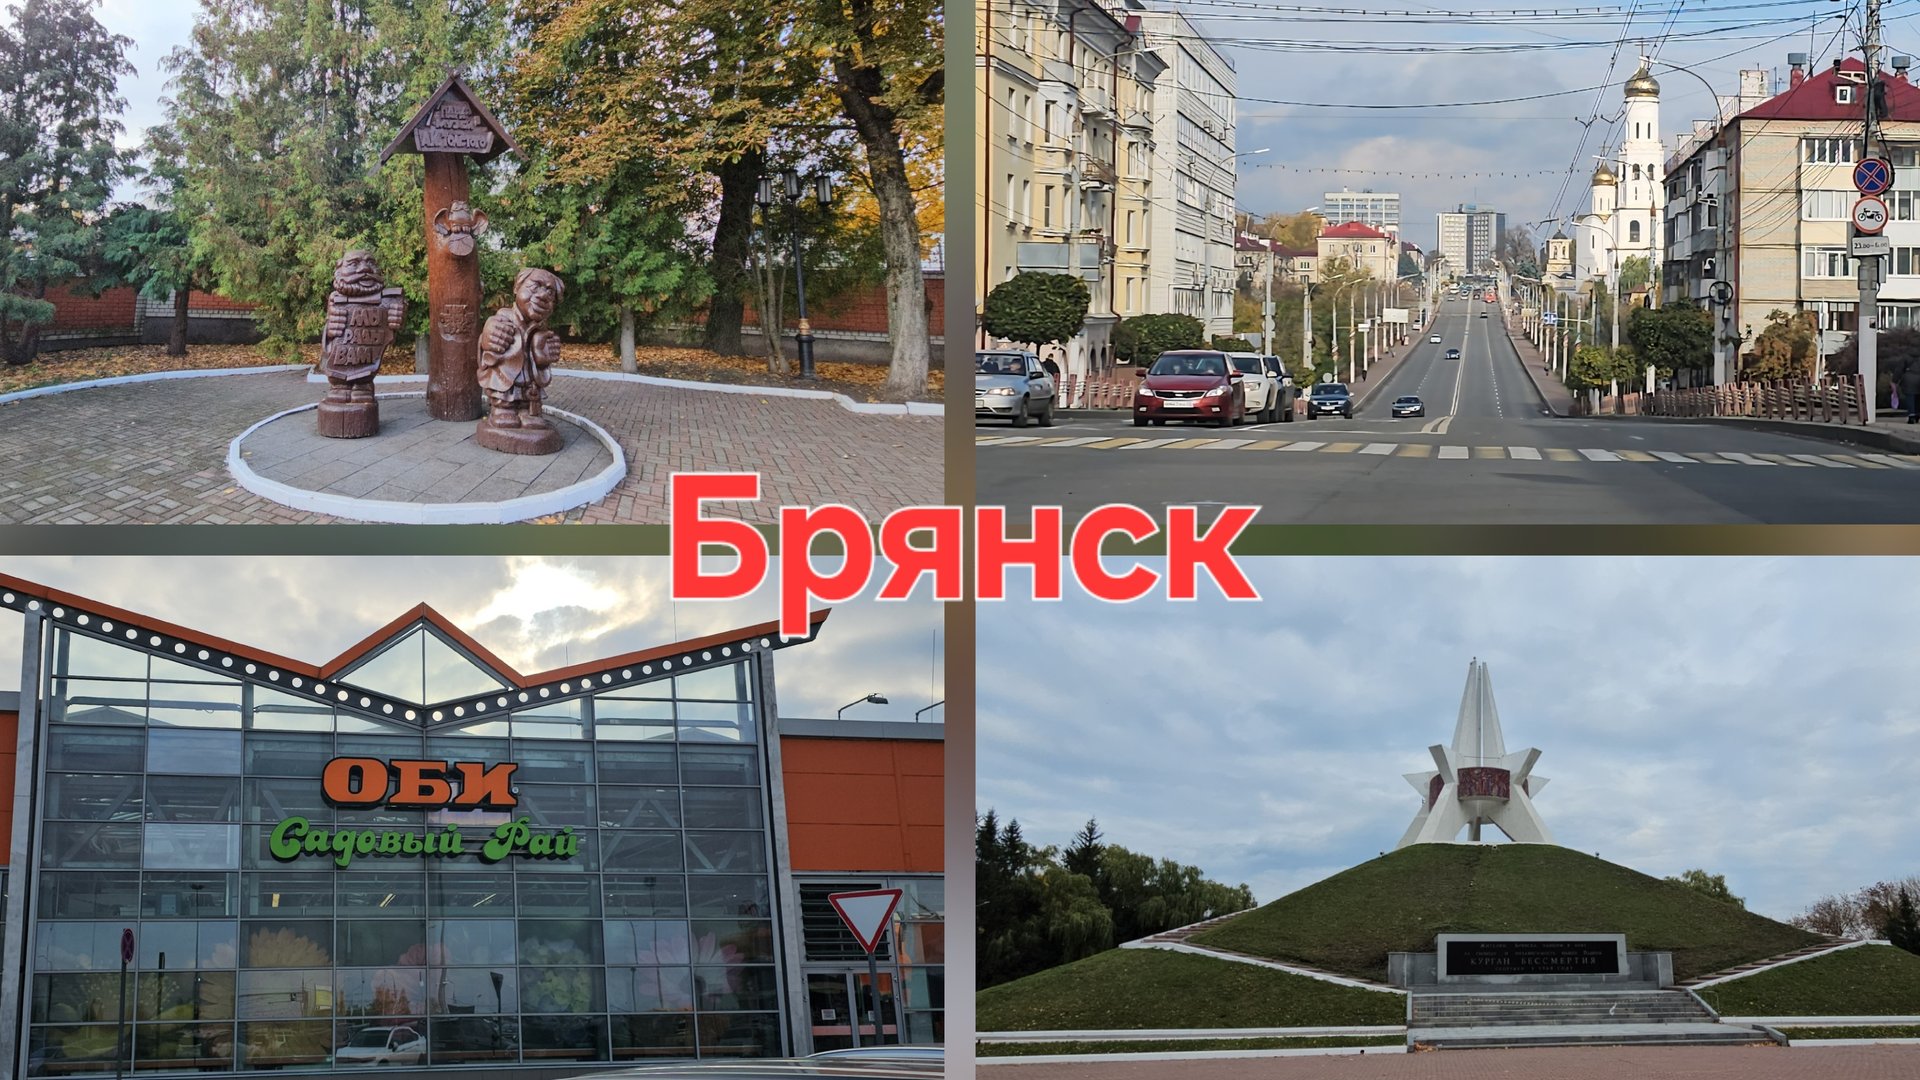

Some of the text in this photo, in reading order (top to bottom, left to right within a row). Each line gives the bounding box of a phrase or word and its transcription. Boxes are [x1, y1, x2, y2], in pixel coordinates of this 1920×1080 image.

[321, 756, 518, 808] ОБИ
[269, 816, 579, 867] Садовый Рай
[1470, 956, 1597, 966] КУРГАН БЕССМЕРТИЯ
